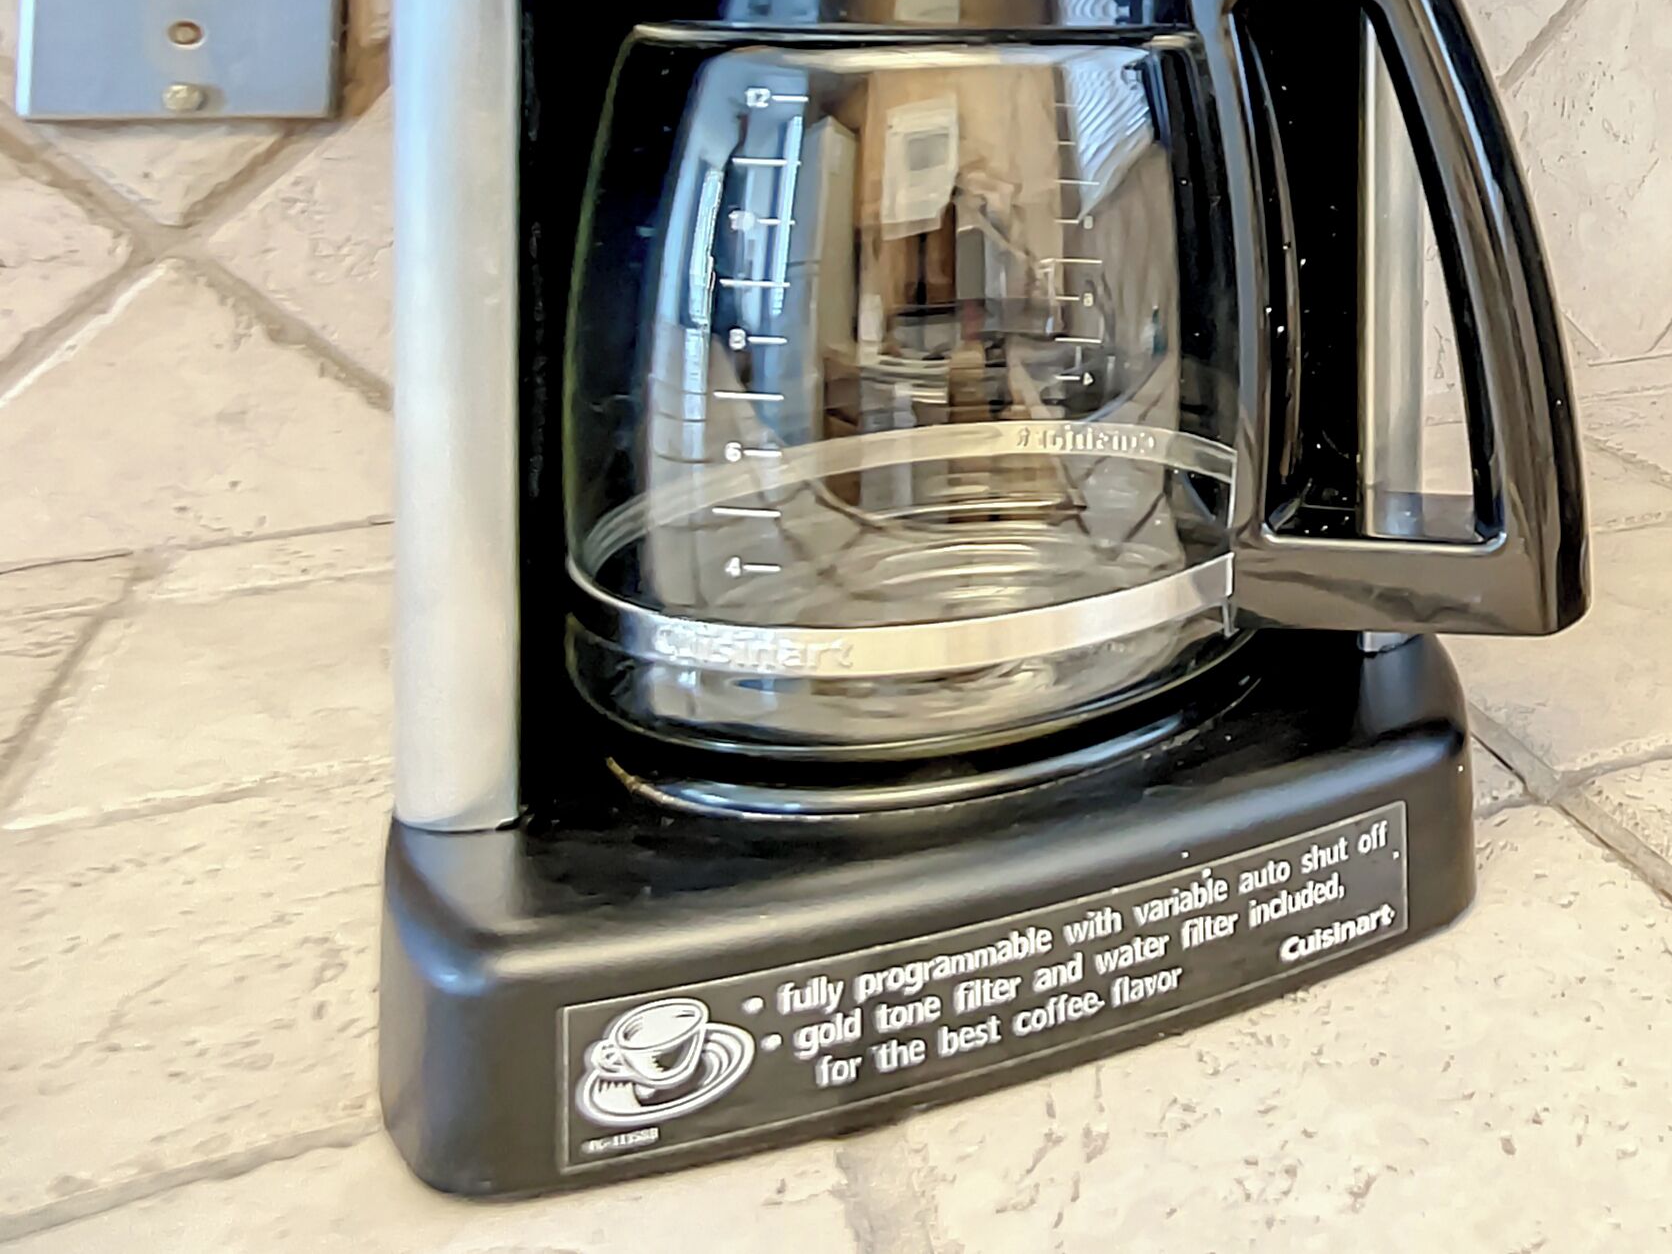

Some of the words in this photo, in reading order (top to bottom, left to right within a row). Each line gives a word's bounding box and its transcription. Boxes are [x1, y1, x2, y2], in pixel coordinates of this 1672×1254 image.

[725, 442, 742, 462] 6
[725, 556, 742, 576] 4
[777, 976, 844, 1015] fully
[853, 926, 1053, 1004] programmable
[1062, 906, 1123, 946] with
[1132, 876, 1229, 927] variable
[1238, 860, 1290, 895] auto
[1300, 836, 1349, 875] shut
[1357, 820, 1388, 854] off
[1278, 903, 1393, 962] Cuisinart
[793, 1007, 863, 1060] gold
[873, 995, 942, 1034] tone
[953, 975, 1022, 1015] filter
[1032, 951, 1084, 993] and
[1094, 934, 1170, 975] water
[1180, 913, 1239, 950] filter
[815, 1054, 863, 1088] for
[874, 1037, 926, 1073] the
[937, 1015, 1002, 1058] best
[1110, 967, 1183, 1008] flavor
